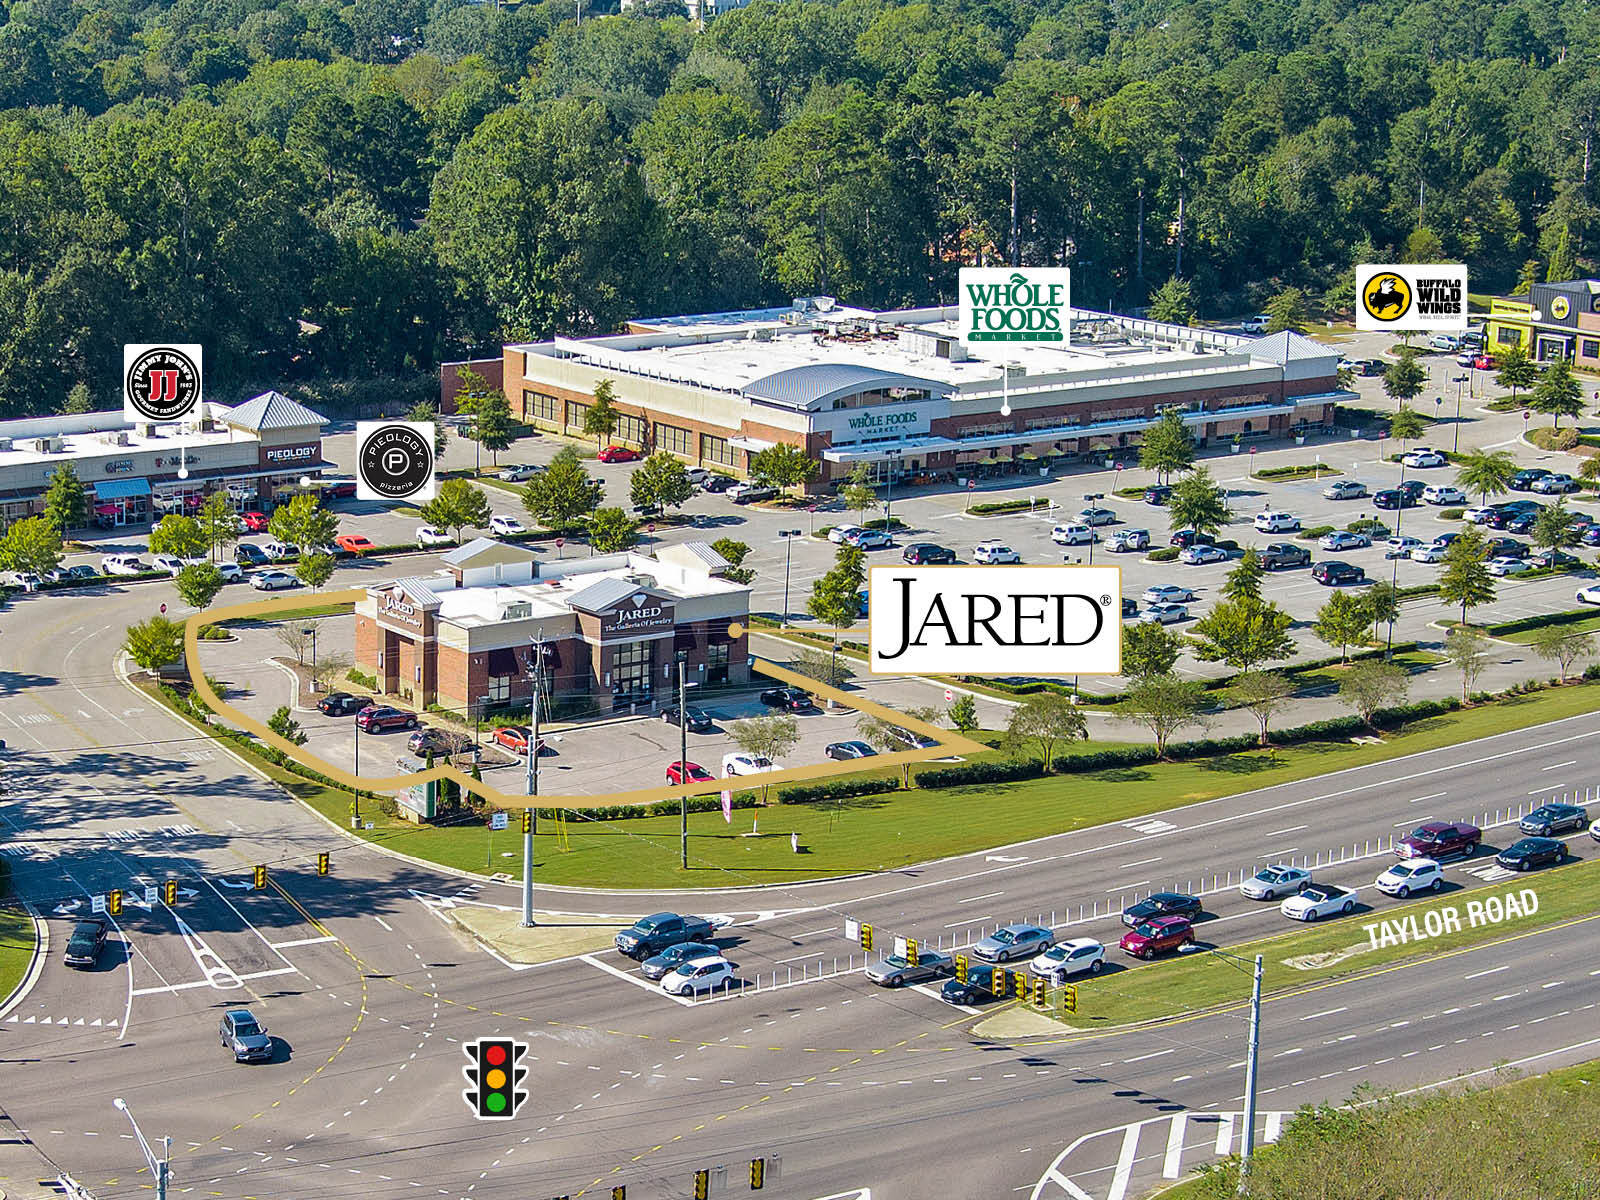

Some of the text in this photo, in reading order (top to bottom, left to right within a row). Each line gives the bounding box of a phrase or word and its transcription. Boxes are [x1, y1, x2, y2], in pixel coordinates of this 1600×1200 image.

[848, 412, 917, 429] WHOLE FOODS
[267, 446, 317, 459] PIEOLOGY
[384, 594, 414, 615] JARED
[616, 607, 662, 624] JARED
